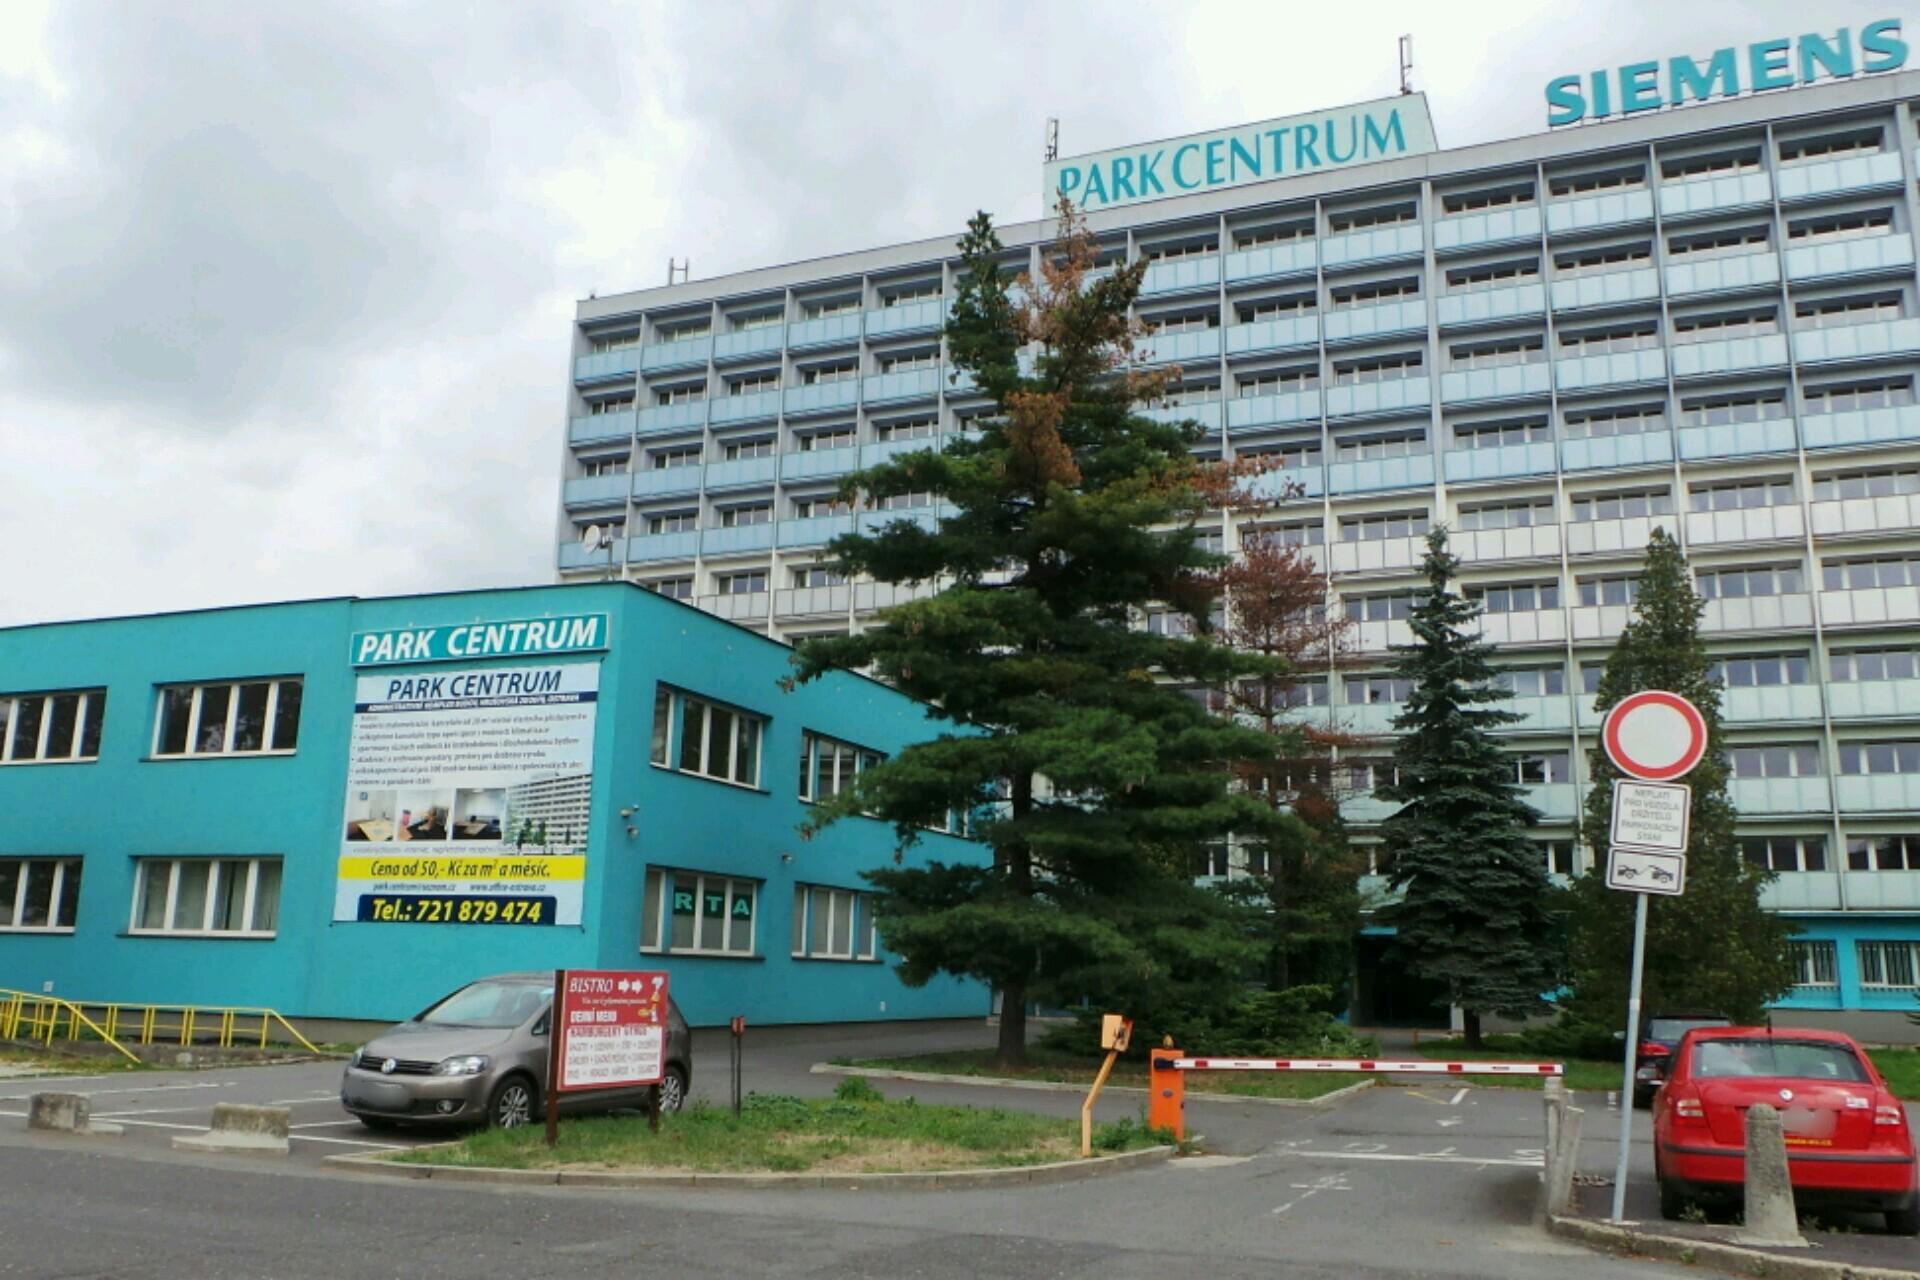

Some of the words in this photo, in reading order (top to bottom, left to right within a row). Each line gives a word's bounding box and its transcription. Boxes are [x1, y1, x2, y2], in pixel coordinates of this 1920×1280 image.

[1544, 18, 1909, 127] SIEMENS
[1060, 150, 1165, 207] PARK
[1172, 108, 1407, 189] CENTRUM
[358, 629, 436, 662] PARK
[447, 617, 599, 656] CENTRUM
[387, 677, 445, 700] PARK
[450, 670, 562, 698] CENTRUM
[371, 861, 400, 876] Cena
[402, 860, 420, 876] od
[421, 860, 445, 878] 50,-
[448, 859, 463, 876] Kč
[463, 864, 478, 876] za
[500, 864, 509, 876] a
[510, 860, 550, 877] měsíc.
[372, 898, 412, 921] Tel.:
[416, 899, 453, 921] 721
[458, 901, 498, 922] 879
[501, 901, 542, 923] 474
[673, 892, 750, 916] RTA
[569, 977, 613, 993] BISTRO
